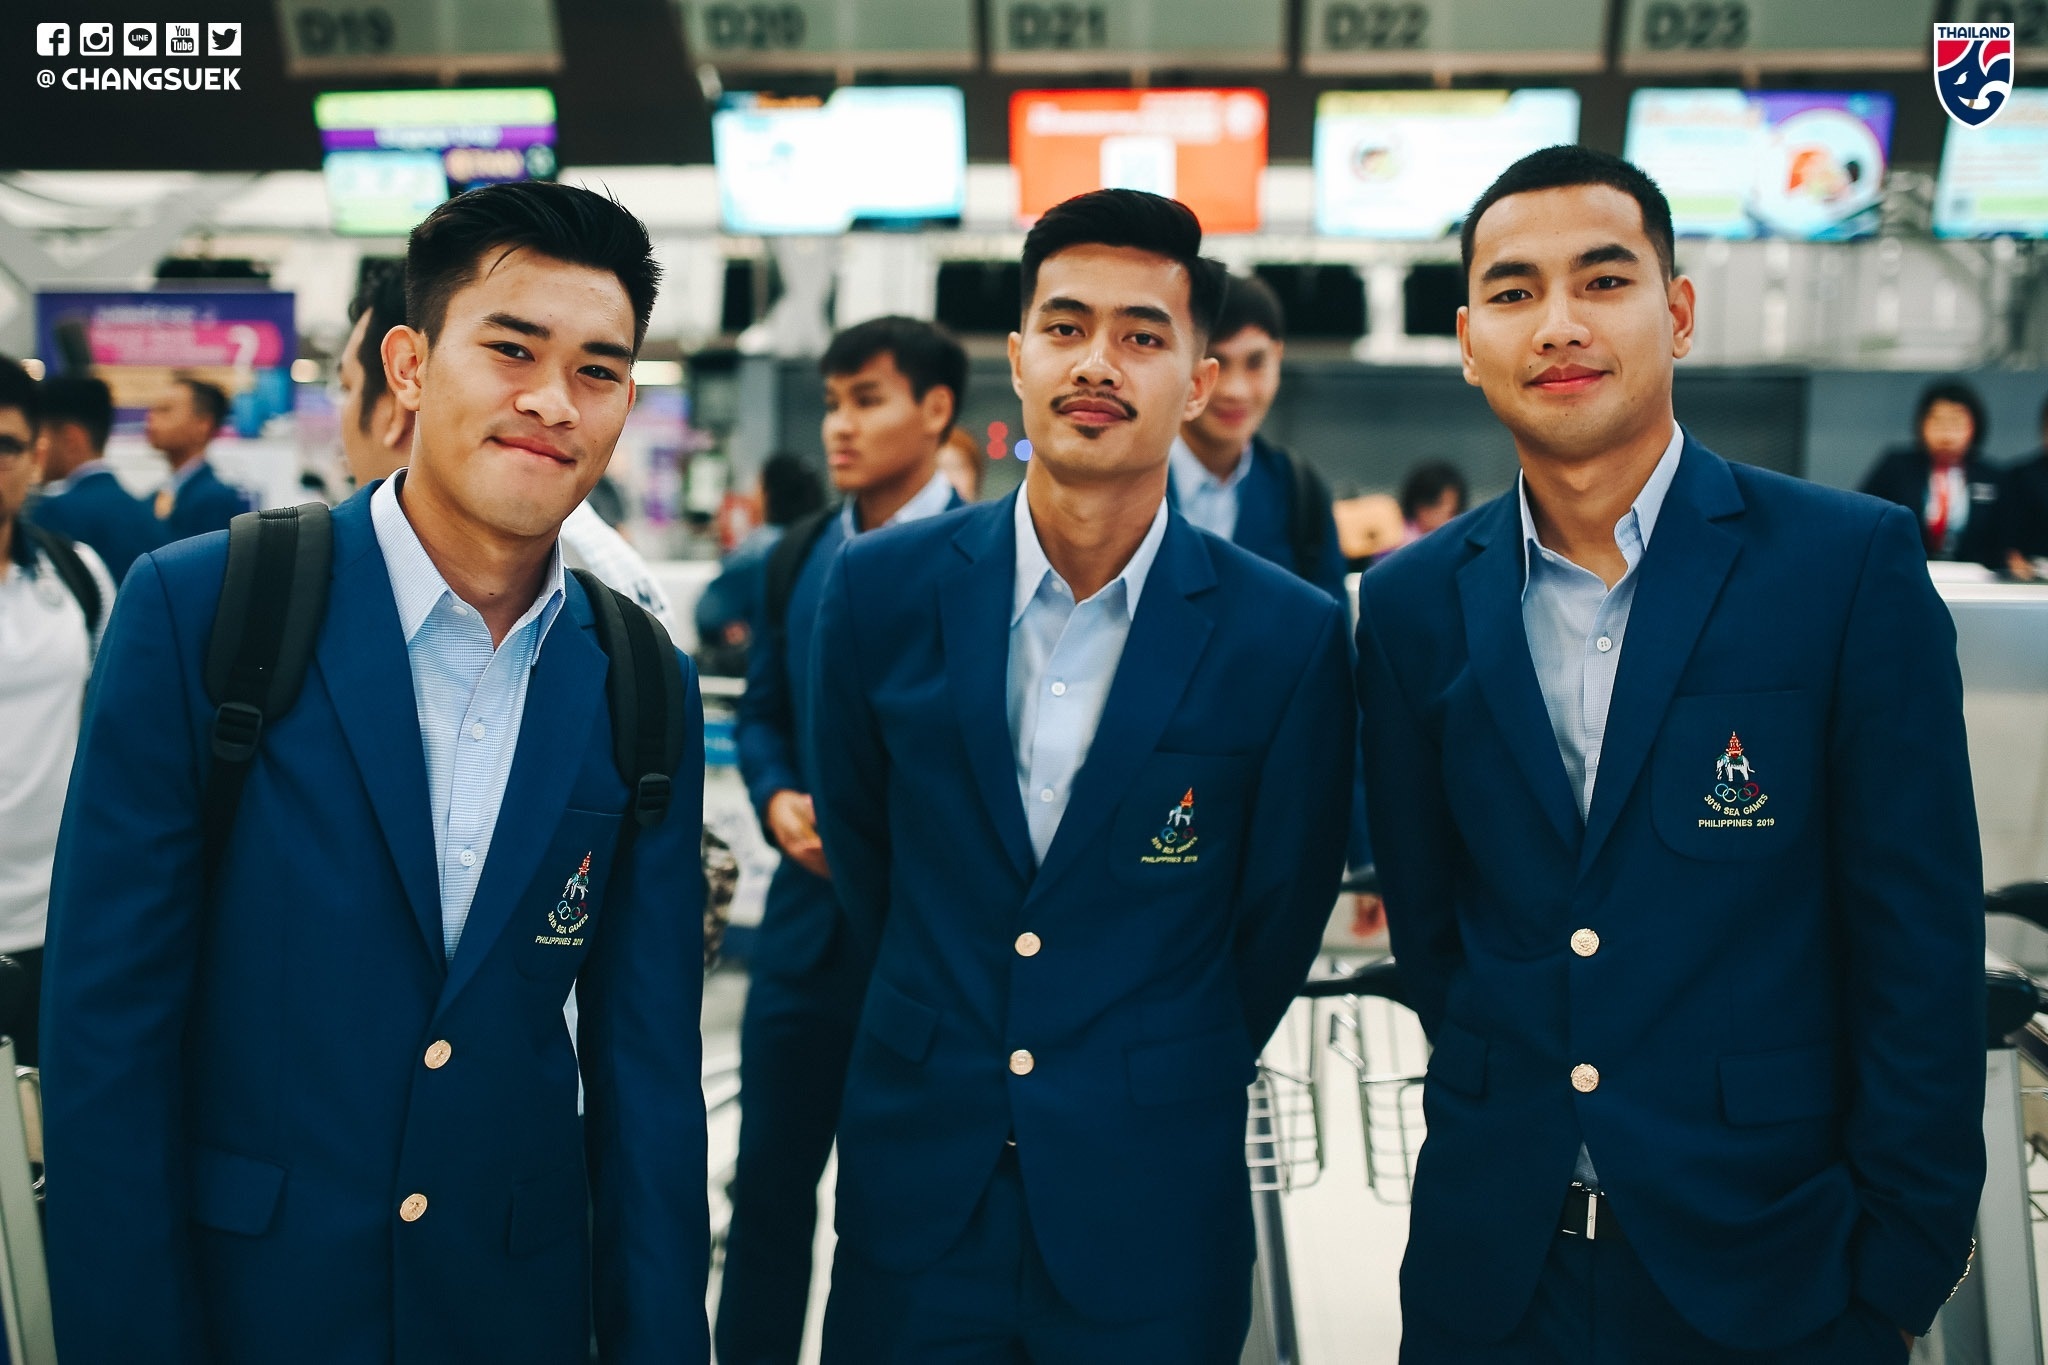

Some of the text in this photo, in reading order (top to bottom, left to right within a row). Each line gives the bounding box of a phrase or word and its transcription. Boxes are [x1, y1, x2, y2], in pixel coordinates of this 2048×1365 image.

[1008, 3, 1106, 49] D21
[1325, 3, 1429, 49] D22
[1704, 793, 1768, 816] 30th SEA GAMES
[1698, 818, 1775, 828] PHILIPPINES 2019
[556, 924, 567, 934] SEA
[568, 913, 589, 934] GAMES
[535, 935, 571, 946] PHILIPPINES
